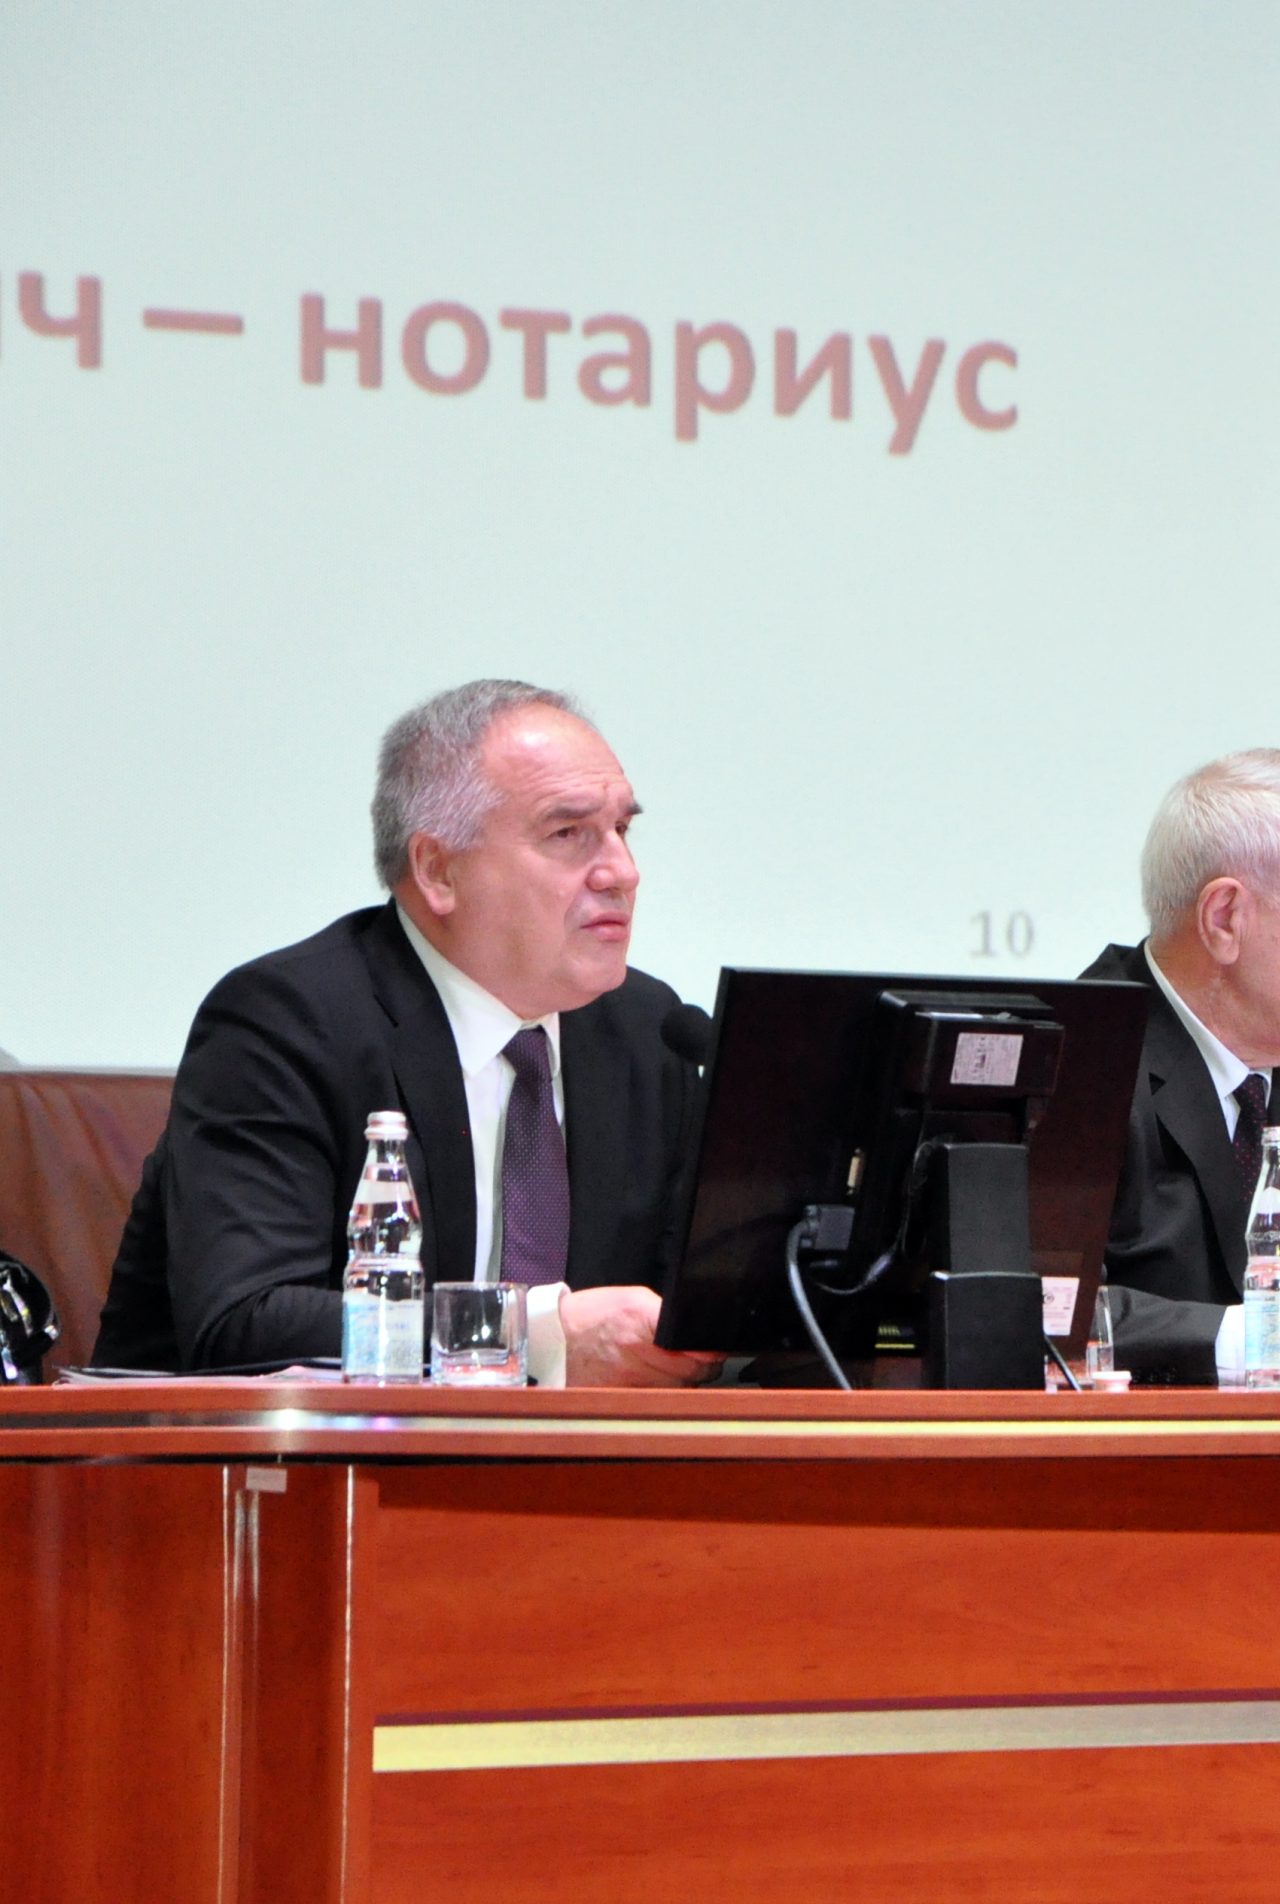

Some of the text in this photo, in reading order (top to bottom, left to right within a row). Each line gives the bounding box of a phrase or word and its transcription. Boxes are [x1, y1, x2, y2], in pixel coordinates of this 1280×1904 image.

[0, 271, 102, 370] ч
[299, 292, 1018, 456] нотариус
[970, 909, 1035, 959] 10
